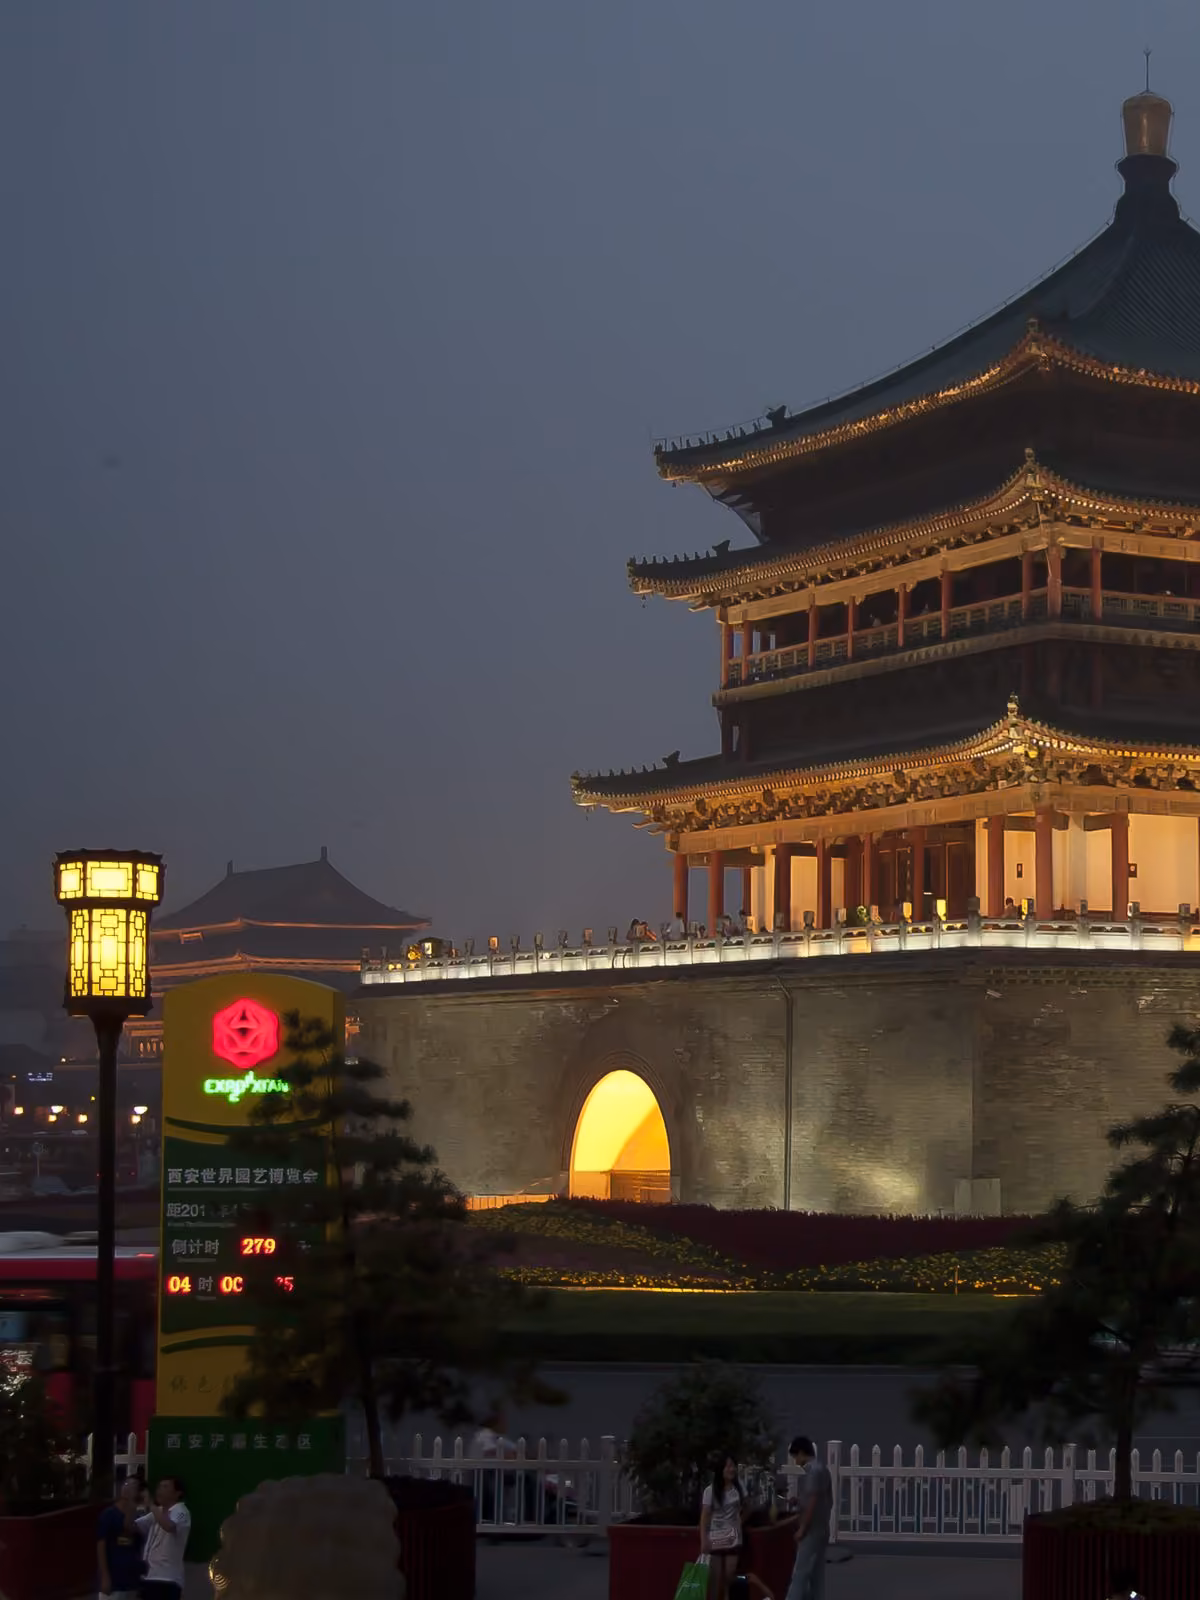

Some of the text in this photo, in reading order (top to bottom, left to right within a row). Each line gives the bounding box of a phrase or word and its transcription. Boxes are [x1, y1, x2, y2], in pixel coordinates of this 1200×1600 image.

[167, 1168, 319, 1184] 西安世界园艺博览会
[172, 1239, 220, 1255] 倒计时
[241, 1238, 277, 1255] 279
[168, 1276, 192, 1293] 04
[198, 1276, 214, 1292] 时
